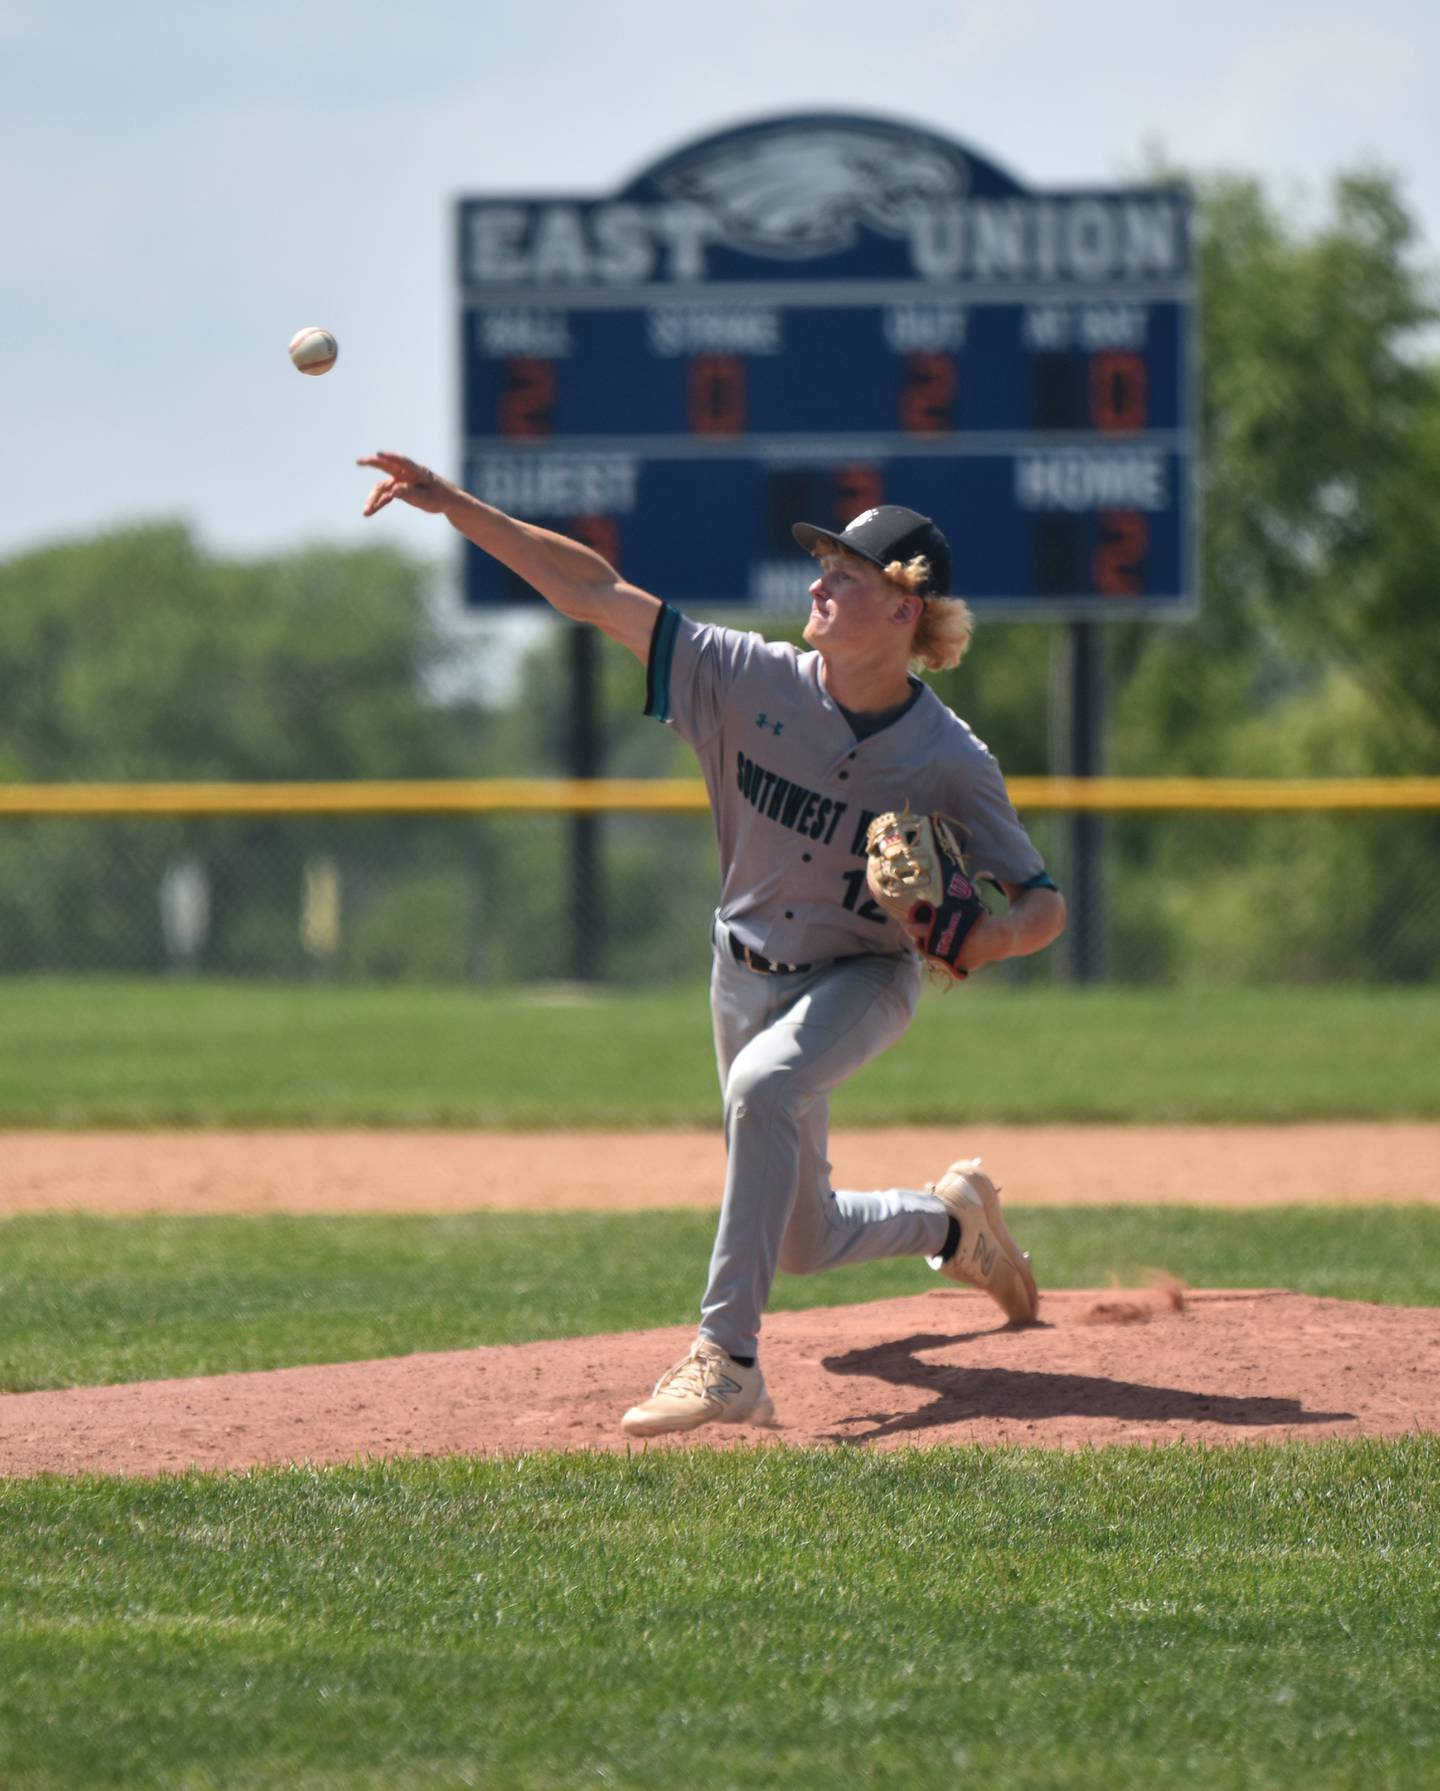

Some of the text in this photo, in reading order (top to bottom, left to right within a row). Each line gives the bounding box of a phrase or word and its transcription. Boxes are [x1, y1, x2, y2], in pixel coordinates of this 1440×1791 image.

[470, 201, 1177, 281] EAST UNION
[498, 357, 556, 438] 2
[687, 355, 747, 438] 0
[898, 353, 957, 436] 2
[1088, 350, 1147, 435] 0
[1092, 508, 1149, 596] 2
[736, 750, 848, 845] SOUTHWEST
